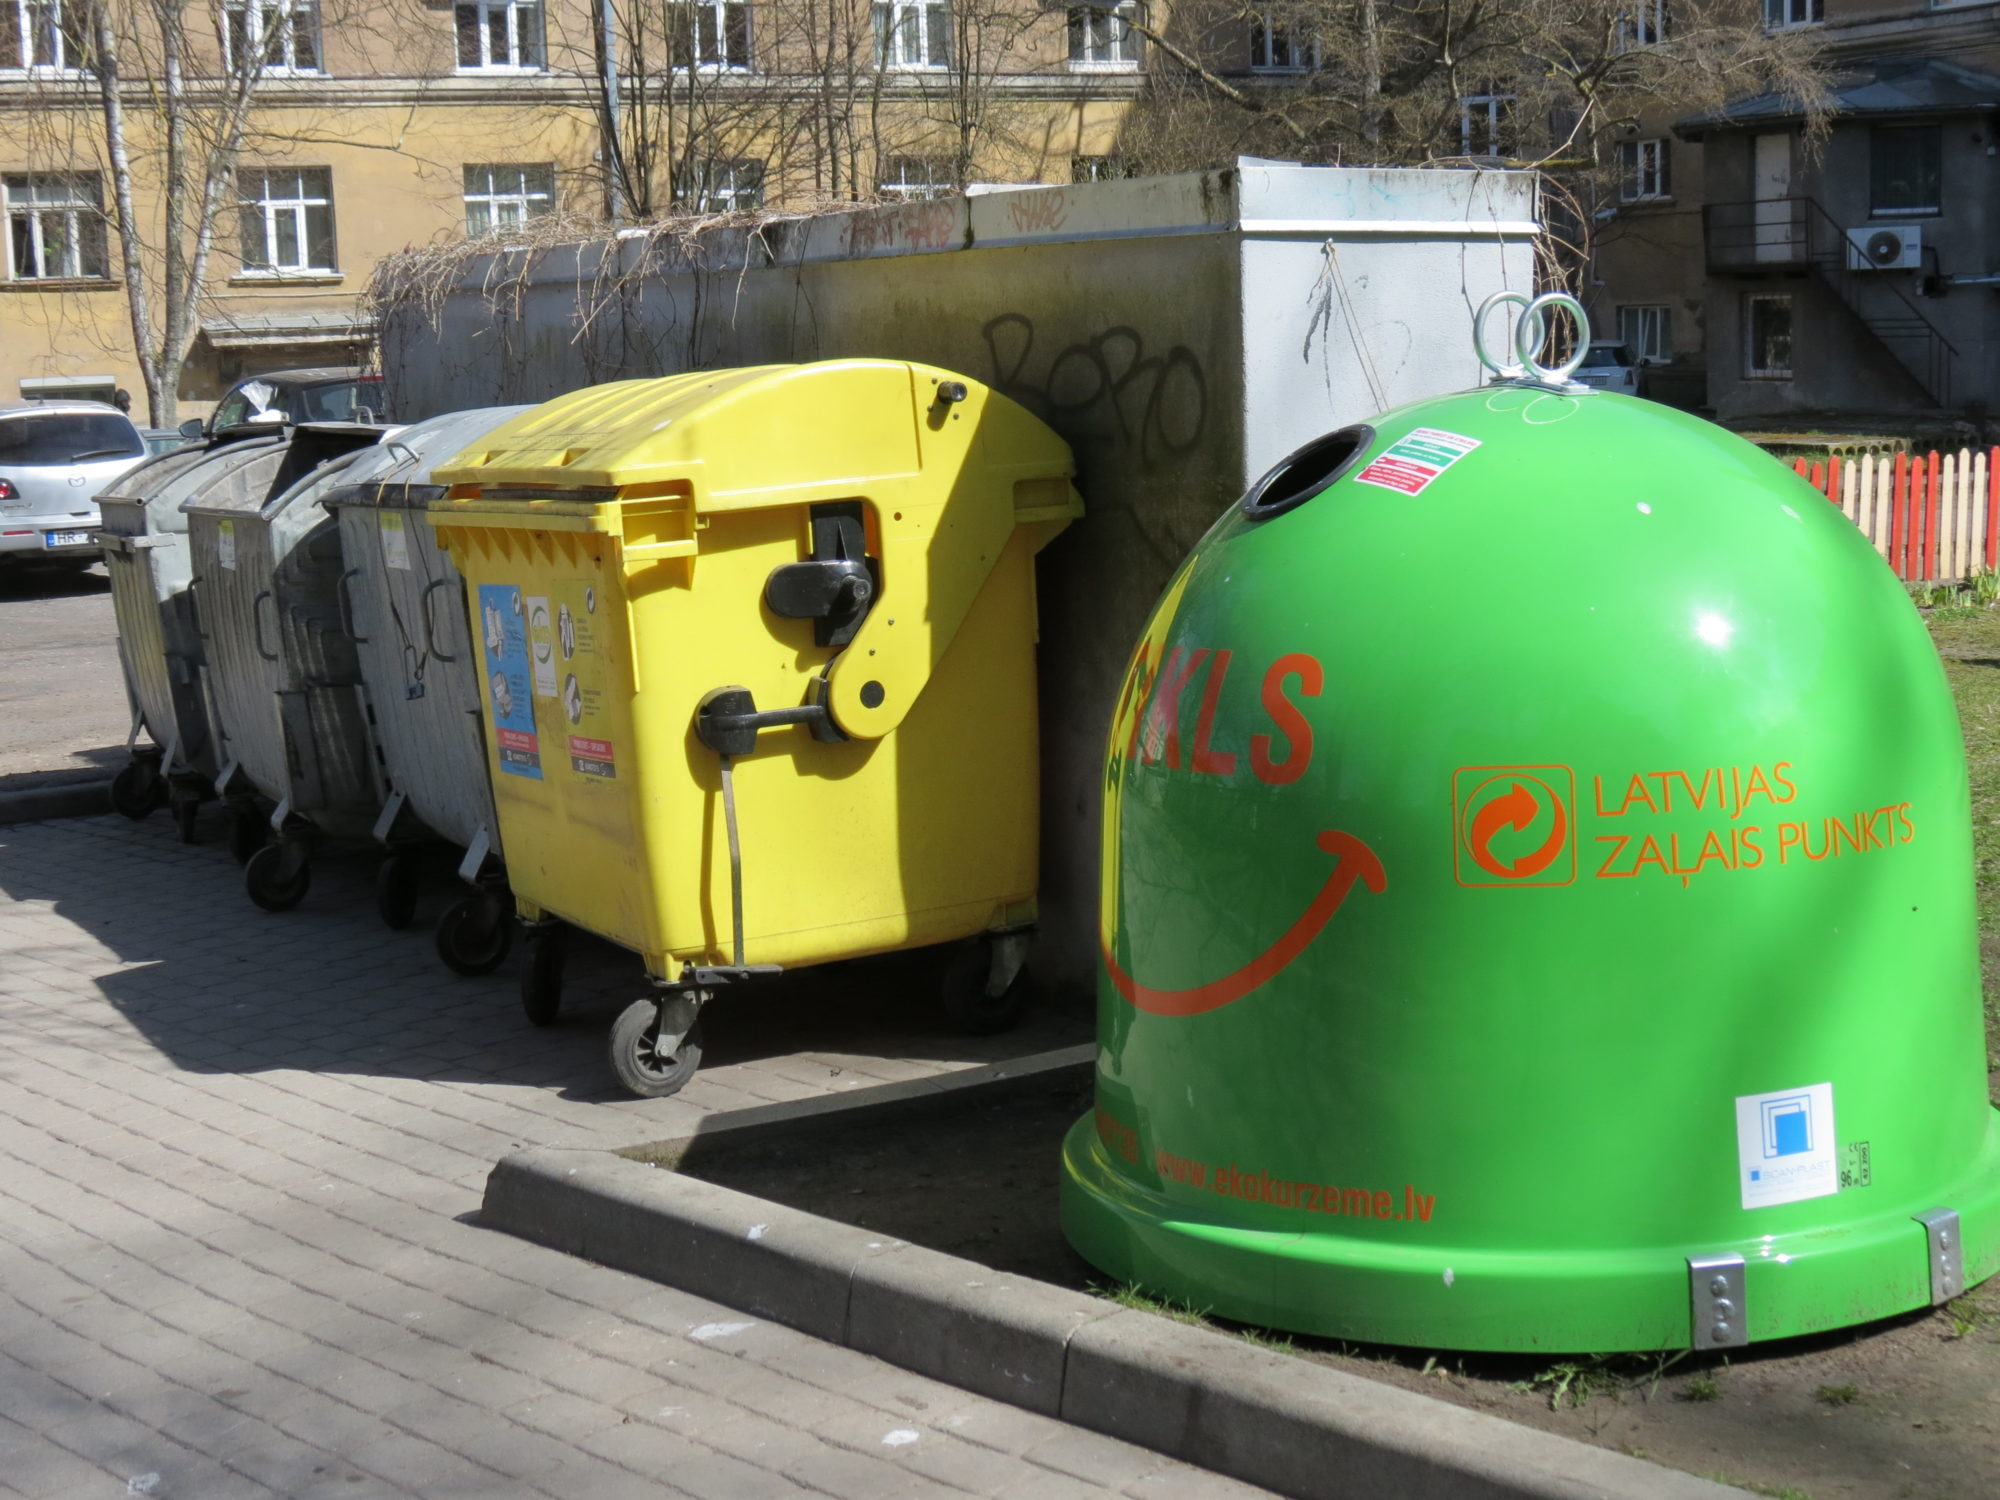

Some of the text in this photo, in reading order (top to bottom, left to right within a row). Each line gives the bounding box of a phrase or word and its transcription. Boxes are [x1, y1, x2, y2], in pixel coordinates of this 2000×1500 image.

[1594, 761, 1798, 819] LATVIJAS
[1596, 802, 1915, 889] ZAĻAIS PUNKTS
[1156, 1151, 1435, 1222] www.ekokurzeme.lv
